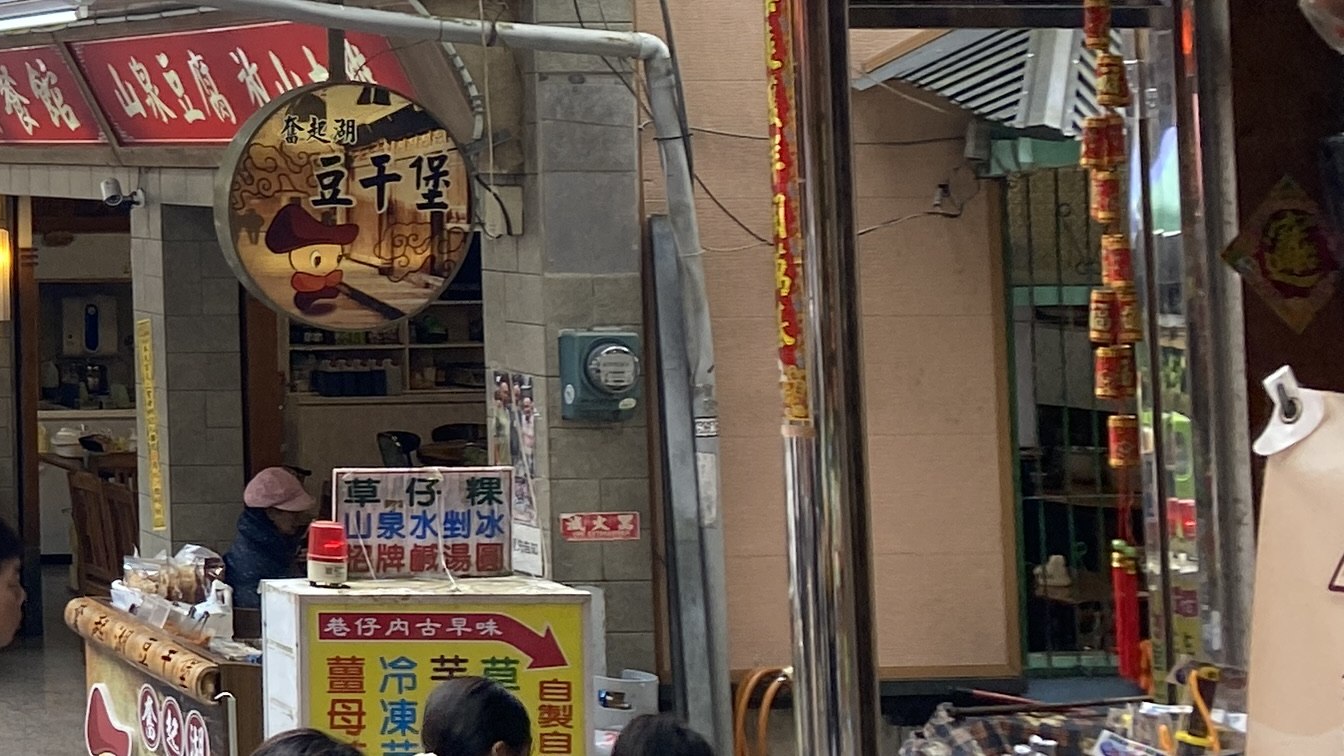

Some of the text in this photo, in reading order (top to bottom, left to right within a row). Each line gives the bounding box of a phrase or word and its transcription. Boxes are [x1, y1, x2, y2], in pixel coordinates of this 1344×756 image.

[107, 49, 237, 125] 山泉豆腐
[281, 115, 357, 145] 奮起湖
[311, 154, 452, 213] 豆干堡
[343, 477, 504, 508] 草仔粿
[324, 617, 504, 638] 巷仔內古早味
[327, 655, 367, 748] 薑母
